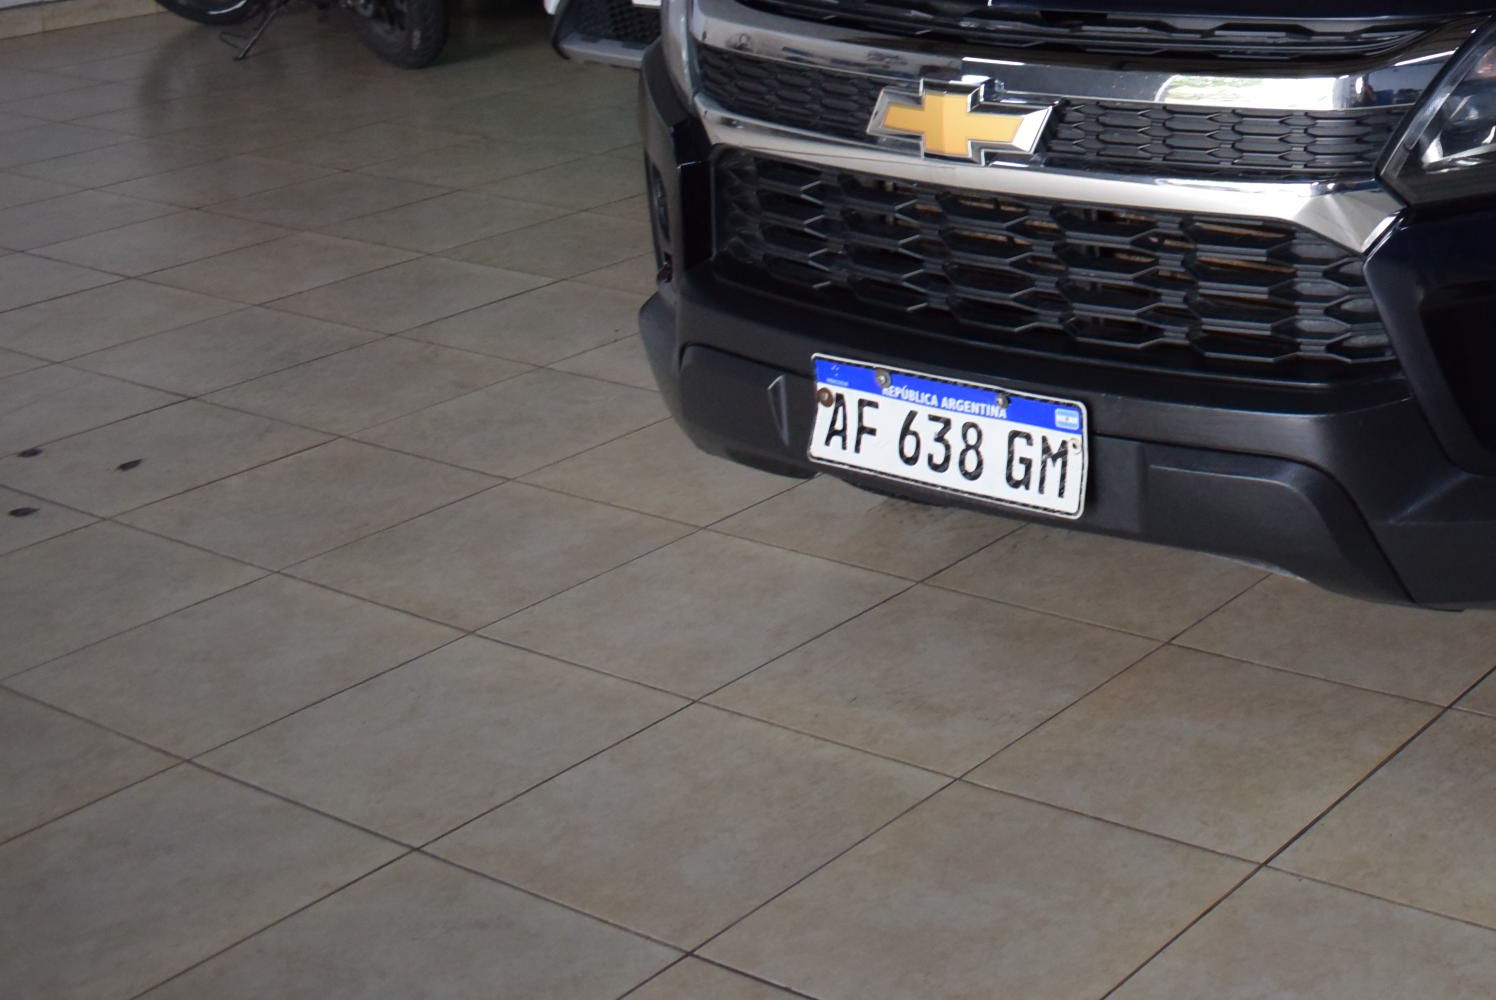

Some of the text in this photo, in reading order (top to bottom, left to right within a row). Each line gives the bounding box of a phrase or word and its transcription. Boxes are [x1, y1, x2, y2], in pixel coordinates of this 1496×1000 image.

[941, 396, 1007, 419] ARGENTINA
[824, 393, 1070, 499] AF 638 GM
